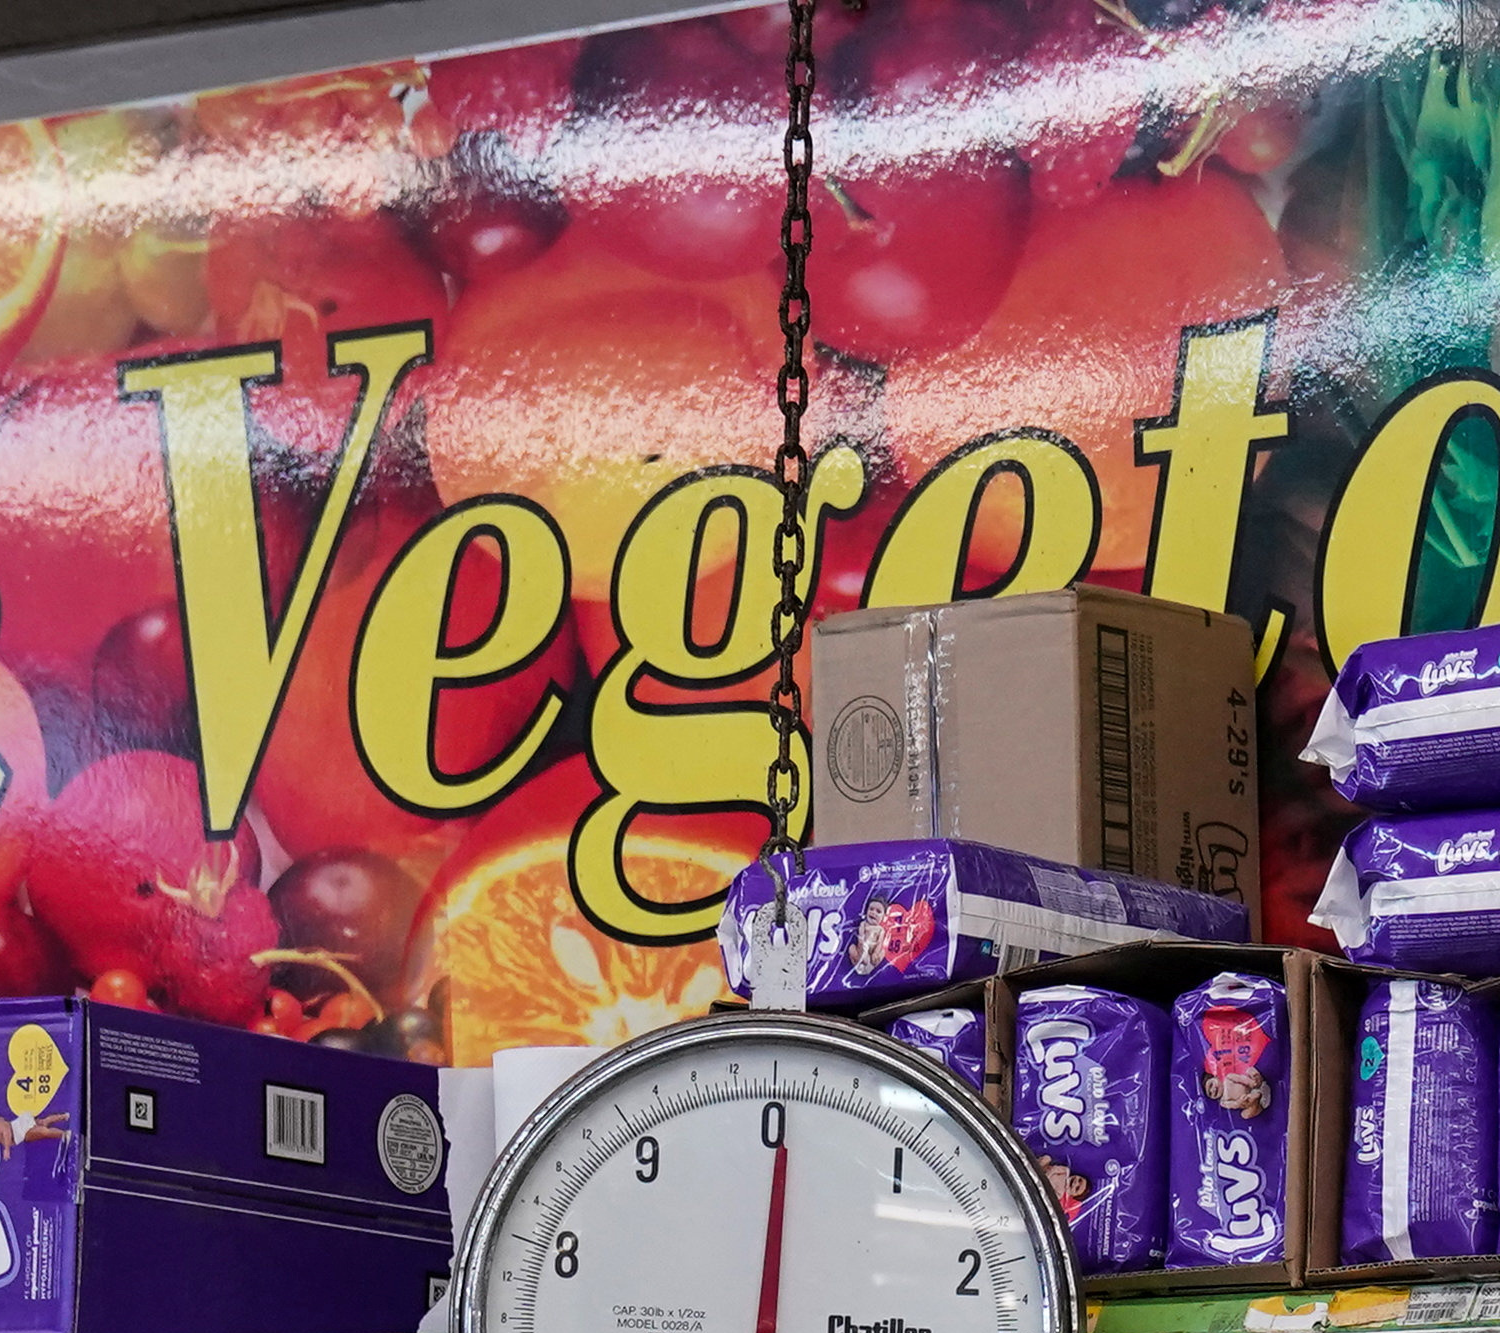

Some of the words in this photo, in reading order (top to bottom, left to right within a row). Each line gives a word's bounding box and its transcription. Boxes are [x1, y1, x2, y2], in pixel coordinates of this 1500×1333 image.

[1420, 657, 1476, 696] Luvs
[1225, 686, 1249, 796] 4-29's
[1436, 838, 1491, 875] Luvs
[15, 1076, 34, 1093] 4
[38, 1074, 52, 1095] 88
[1025, 1017, 1093, 1142] Luvs
[761, 1102, 786, 1149] 0
[1357, 1106, 1381, 1164] Luvs
[636, 1137, 659, 1183] 9
[893, 1148, 902, 1193] 1
[1210, 1133, 1283, 1253] Luvs
[555, 1232, 579, 1278] 8
[958, 1250, 980, 1295] 2
[612, 1305, 637, 1317] CAP.
[677, 1308, 706, 1319] 1/2oz
[617, 1318, 658, 1330] MODEL
[661, 1320, 703, 1331] 0028/A
